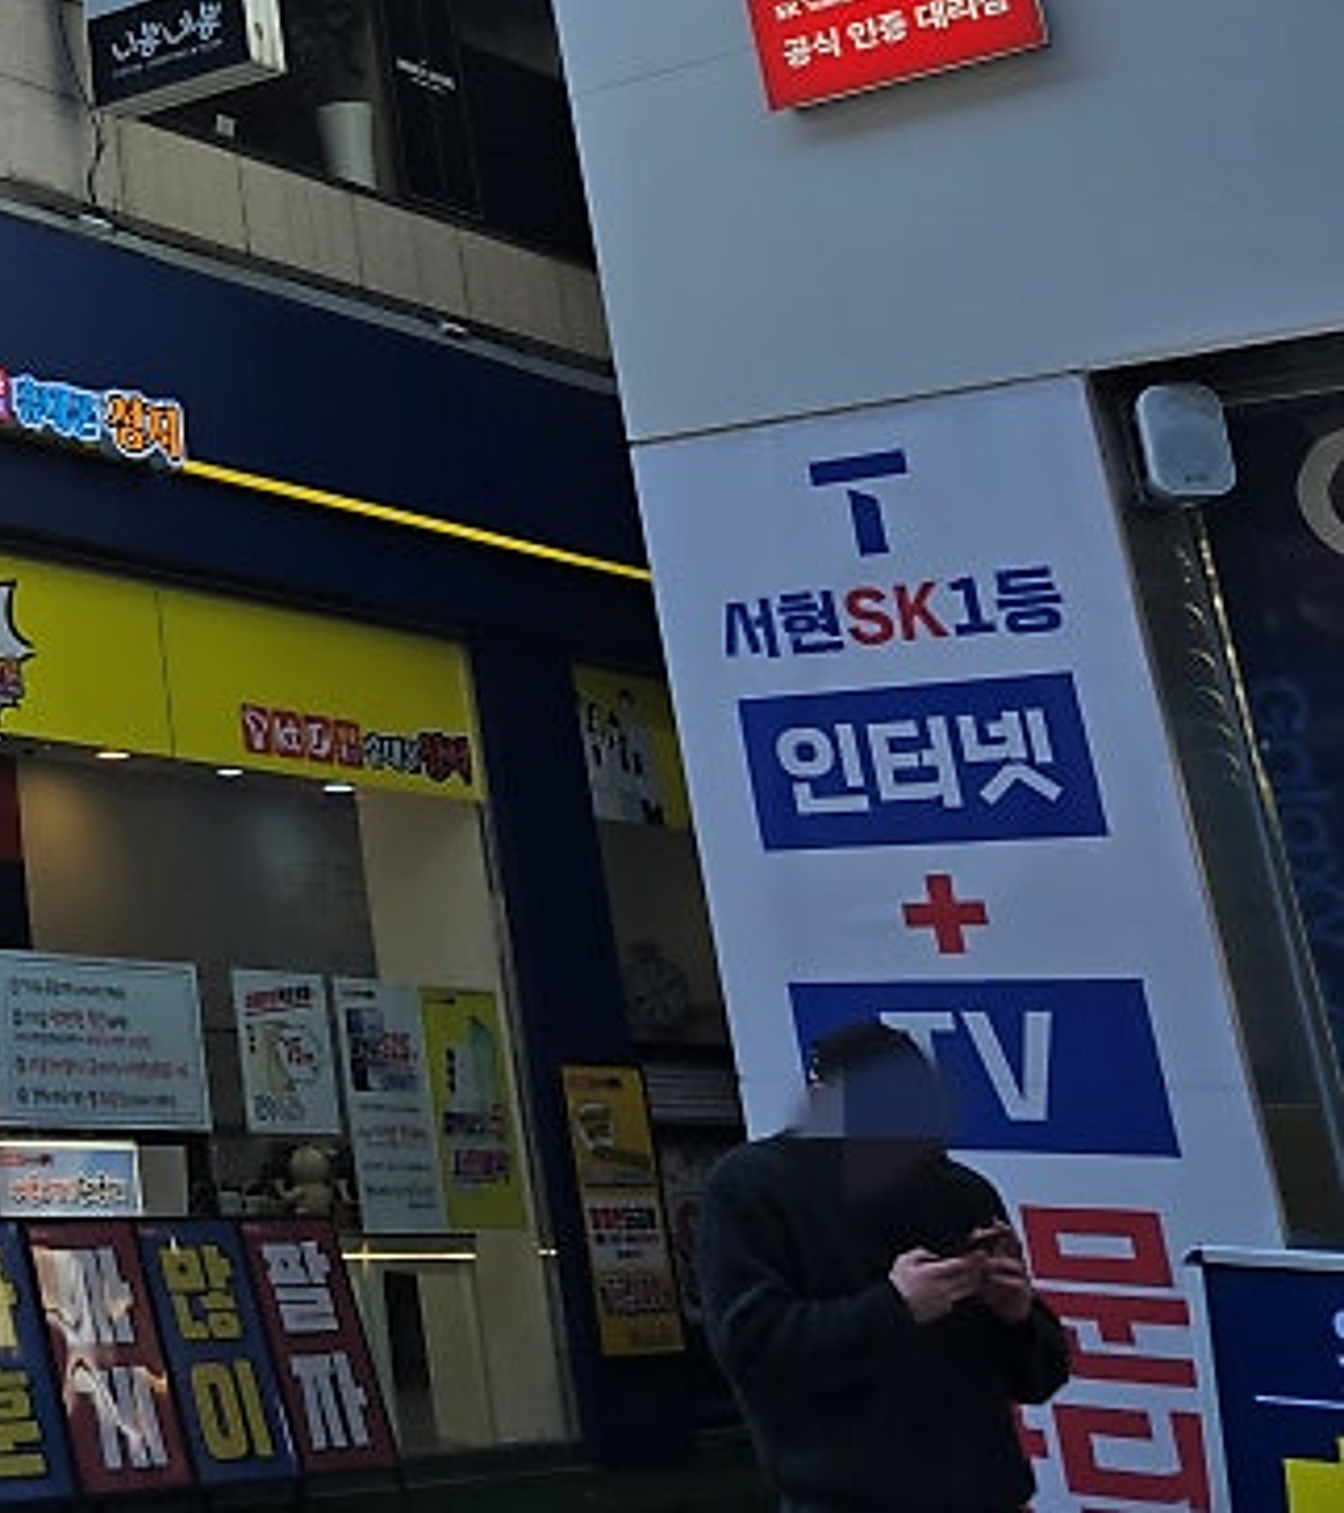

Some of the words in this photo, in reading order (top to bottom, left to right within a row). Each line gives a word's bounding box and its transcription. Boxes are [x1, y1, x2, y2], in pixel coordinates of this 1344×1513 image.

[782, 28, 842, 69] 공식
[846, 9, 907, 51] 인증
[722, 564, 1064, 660] 서현SK1등
[773, 706, 1065, 816] 인터넷
